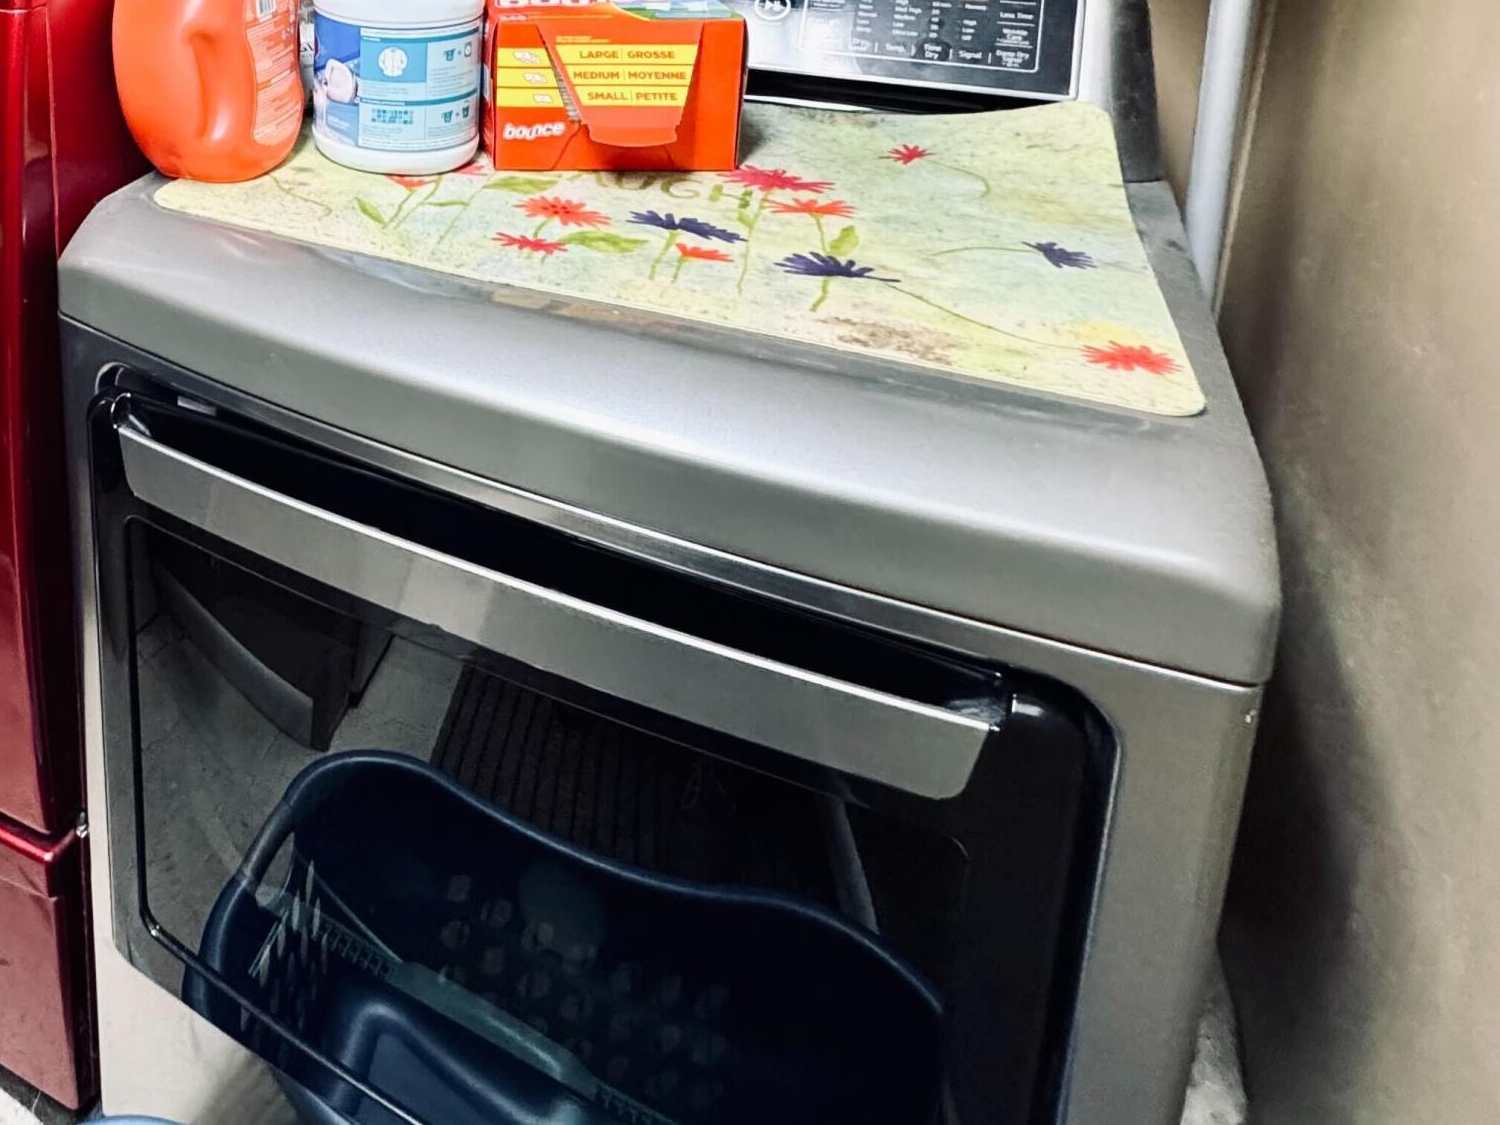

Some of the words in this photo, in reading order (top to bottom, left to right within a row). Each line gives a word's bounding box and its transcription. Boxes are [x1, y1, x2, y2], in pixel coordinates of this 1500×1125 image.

[579, 49, 619, 60] LARGE
[627, 49, 676, 60] GROSSE
[573, 71, 620, 80] MEDIUM
[627, 71, 687, 81] MOYENNE
[587, 91, 628, 101] SMALL
[636, 92, 678, 102] PETITE
[502, 121, 566, 141] bounce
